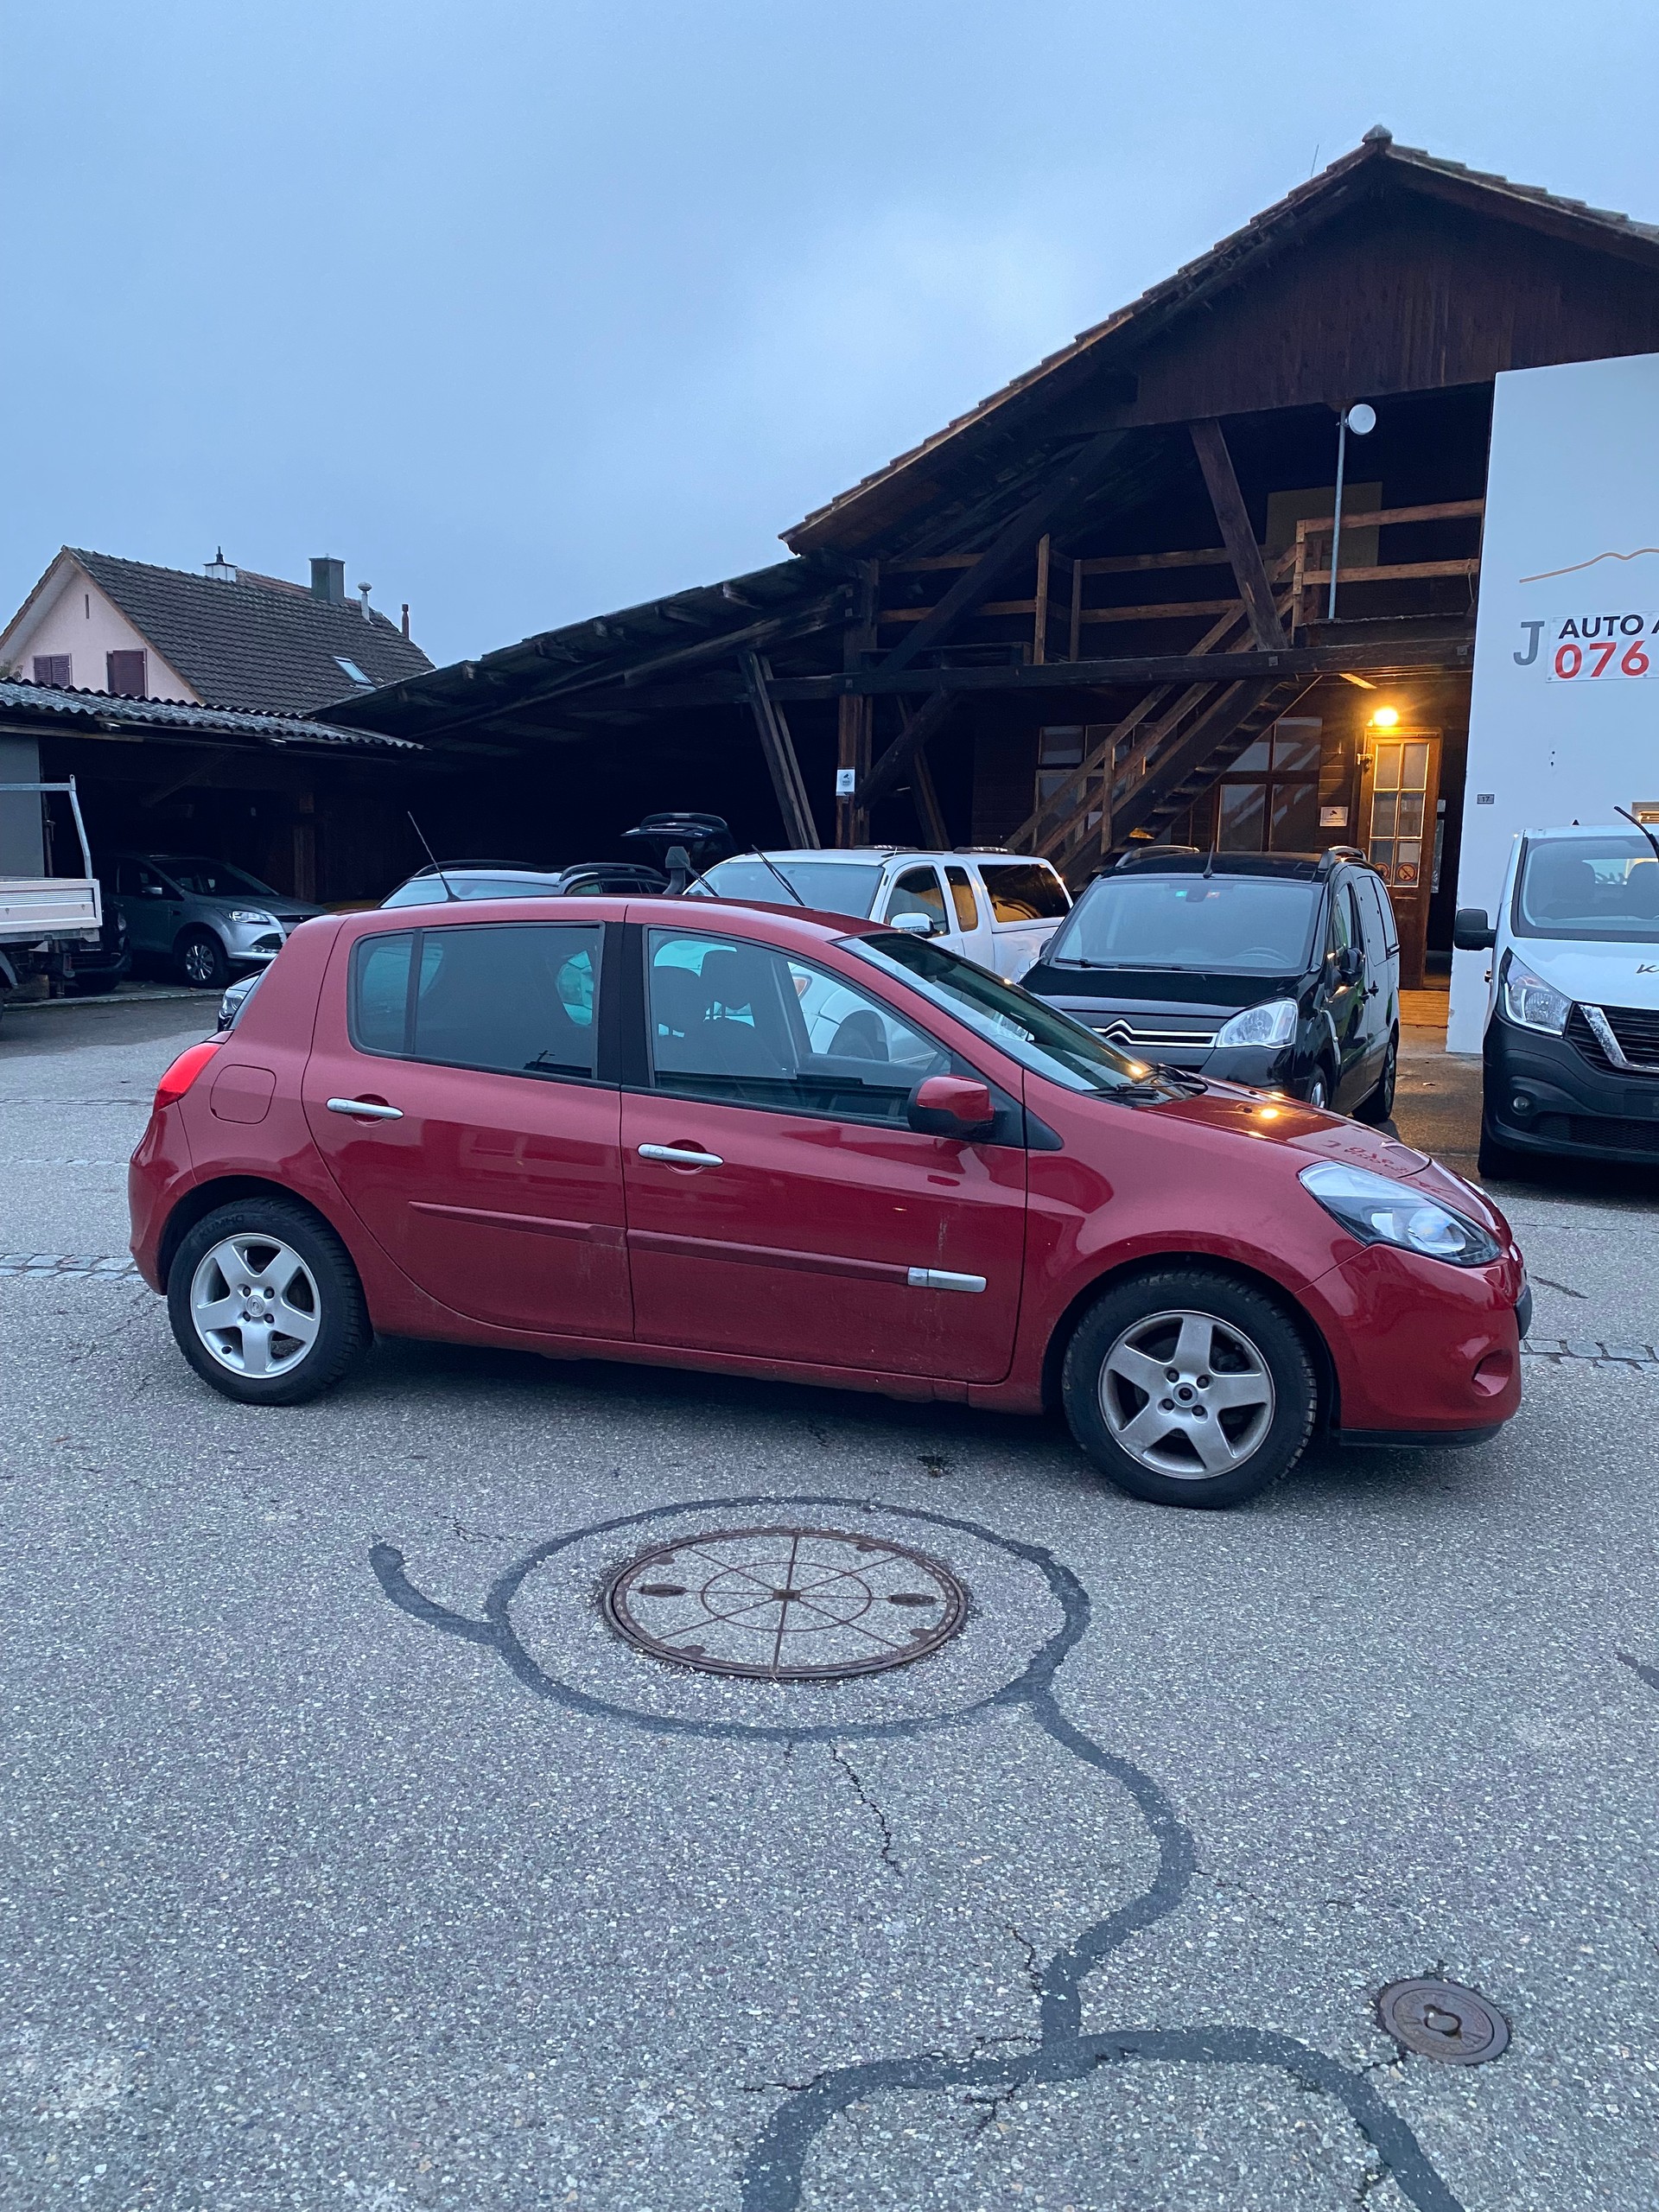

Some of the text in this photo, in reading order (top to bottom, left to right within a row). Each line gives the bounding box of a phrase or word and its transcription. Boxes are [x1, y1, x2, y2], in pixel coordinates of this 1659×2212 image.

[1513, 620, 1546, 666] J
[1558, 614, 1644, 639] AUTO
[1554, 640, 1649, 679] 076
